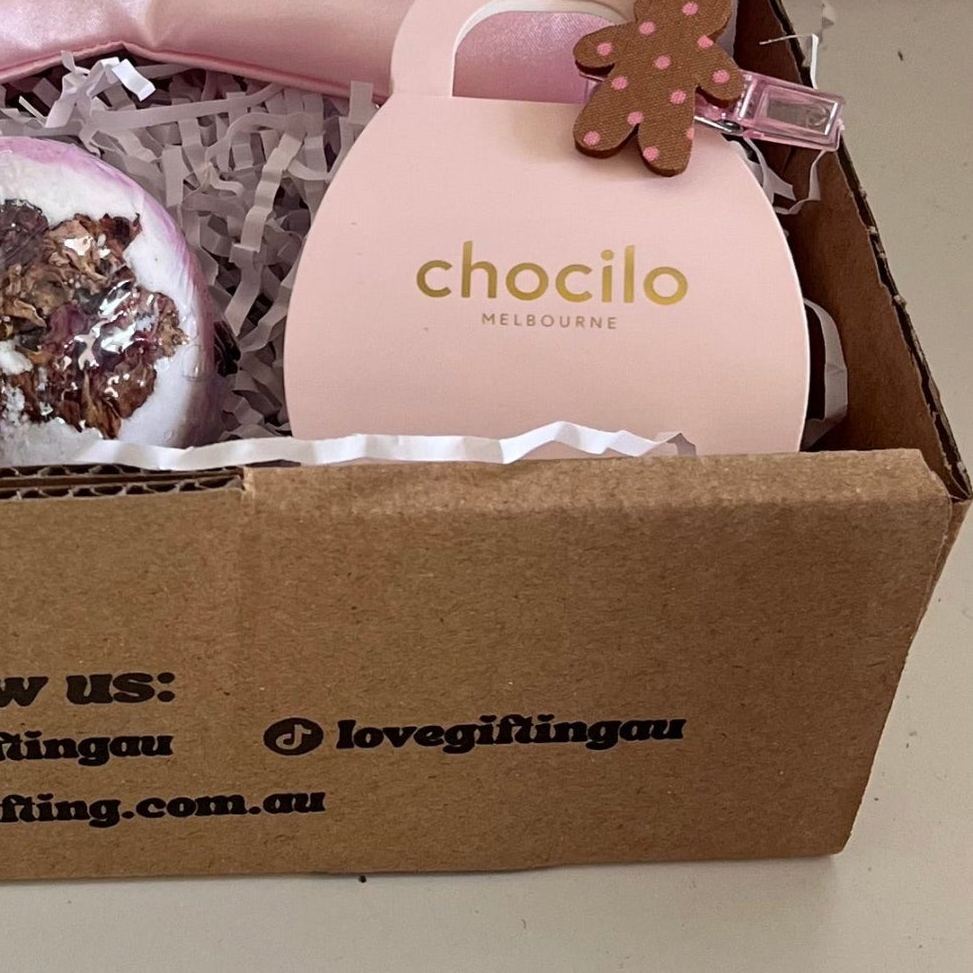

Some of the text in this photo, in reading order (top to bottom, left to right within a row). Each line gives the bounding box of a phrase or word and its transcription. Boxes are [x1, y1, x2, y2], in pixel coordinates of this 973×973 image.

[417, 241, 688, 305] chocilo
[482, 313, 617, 329] MELBOURNE
[66, 672, 175, 705] us:
[337, 714, 686, 754] lovegiftingau
